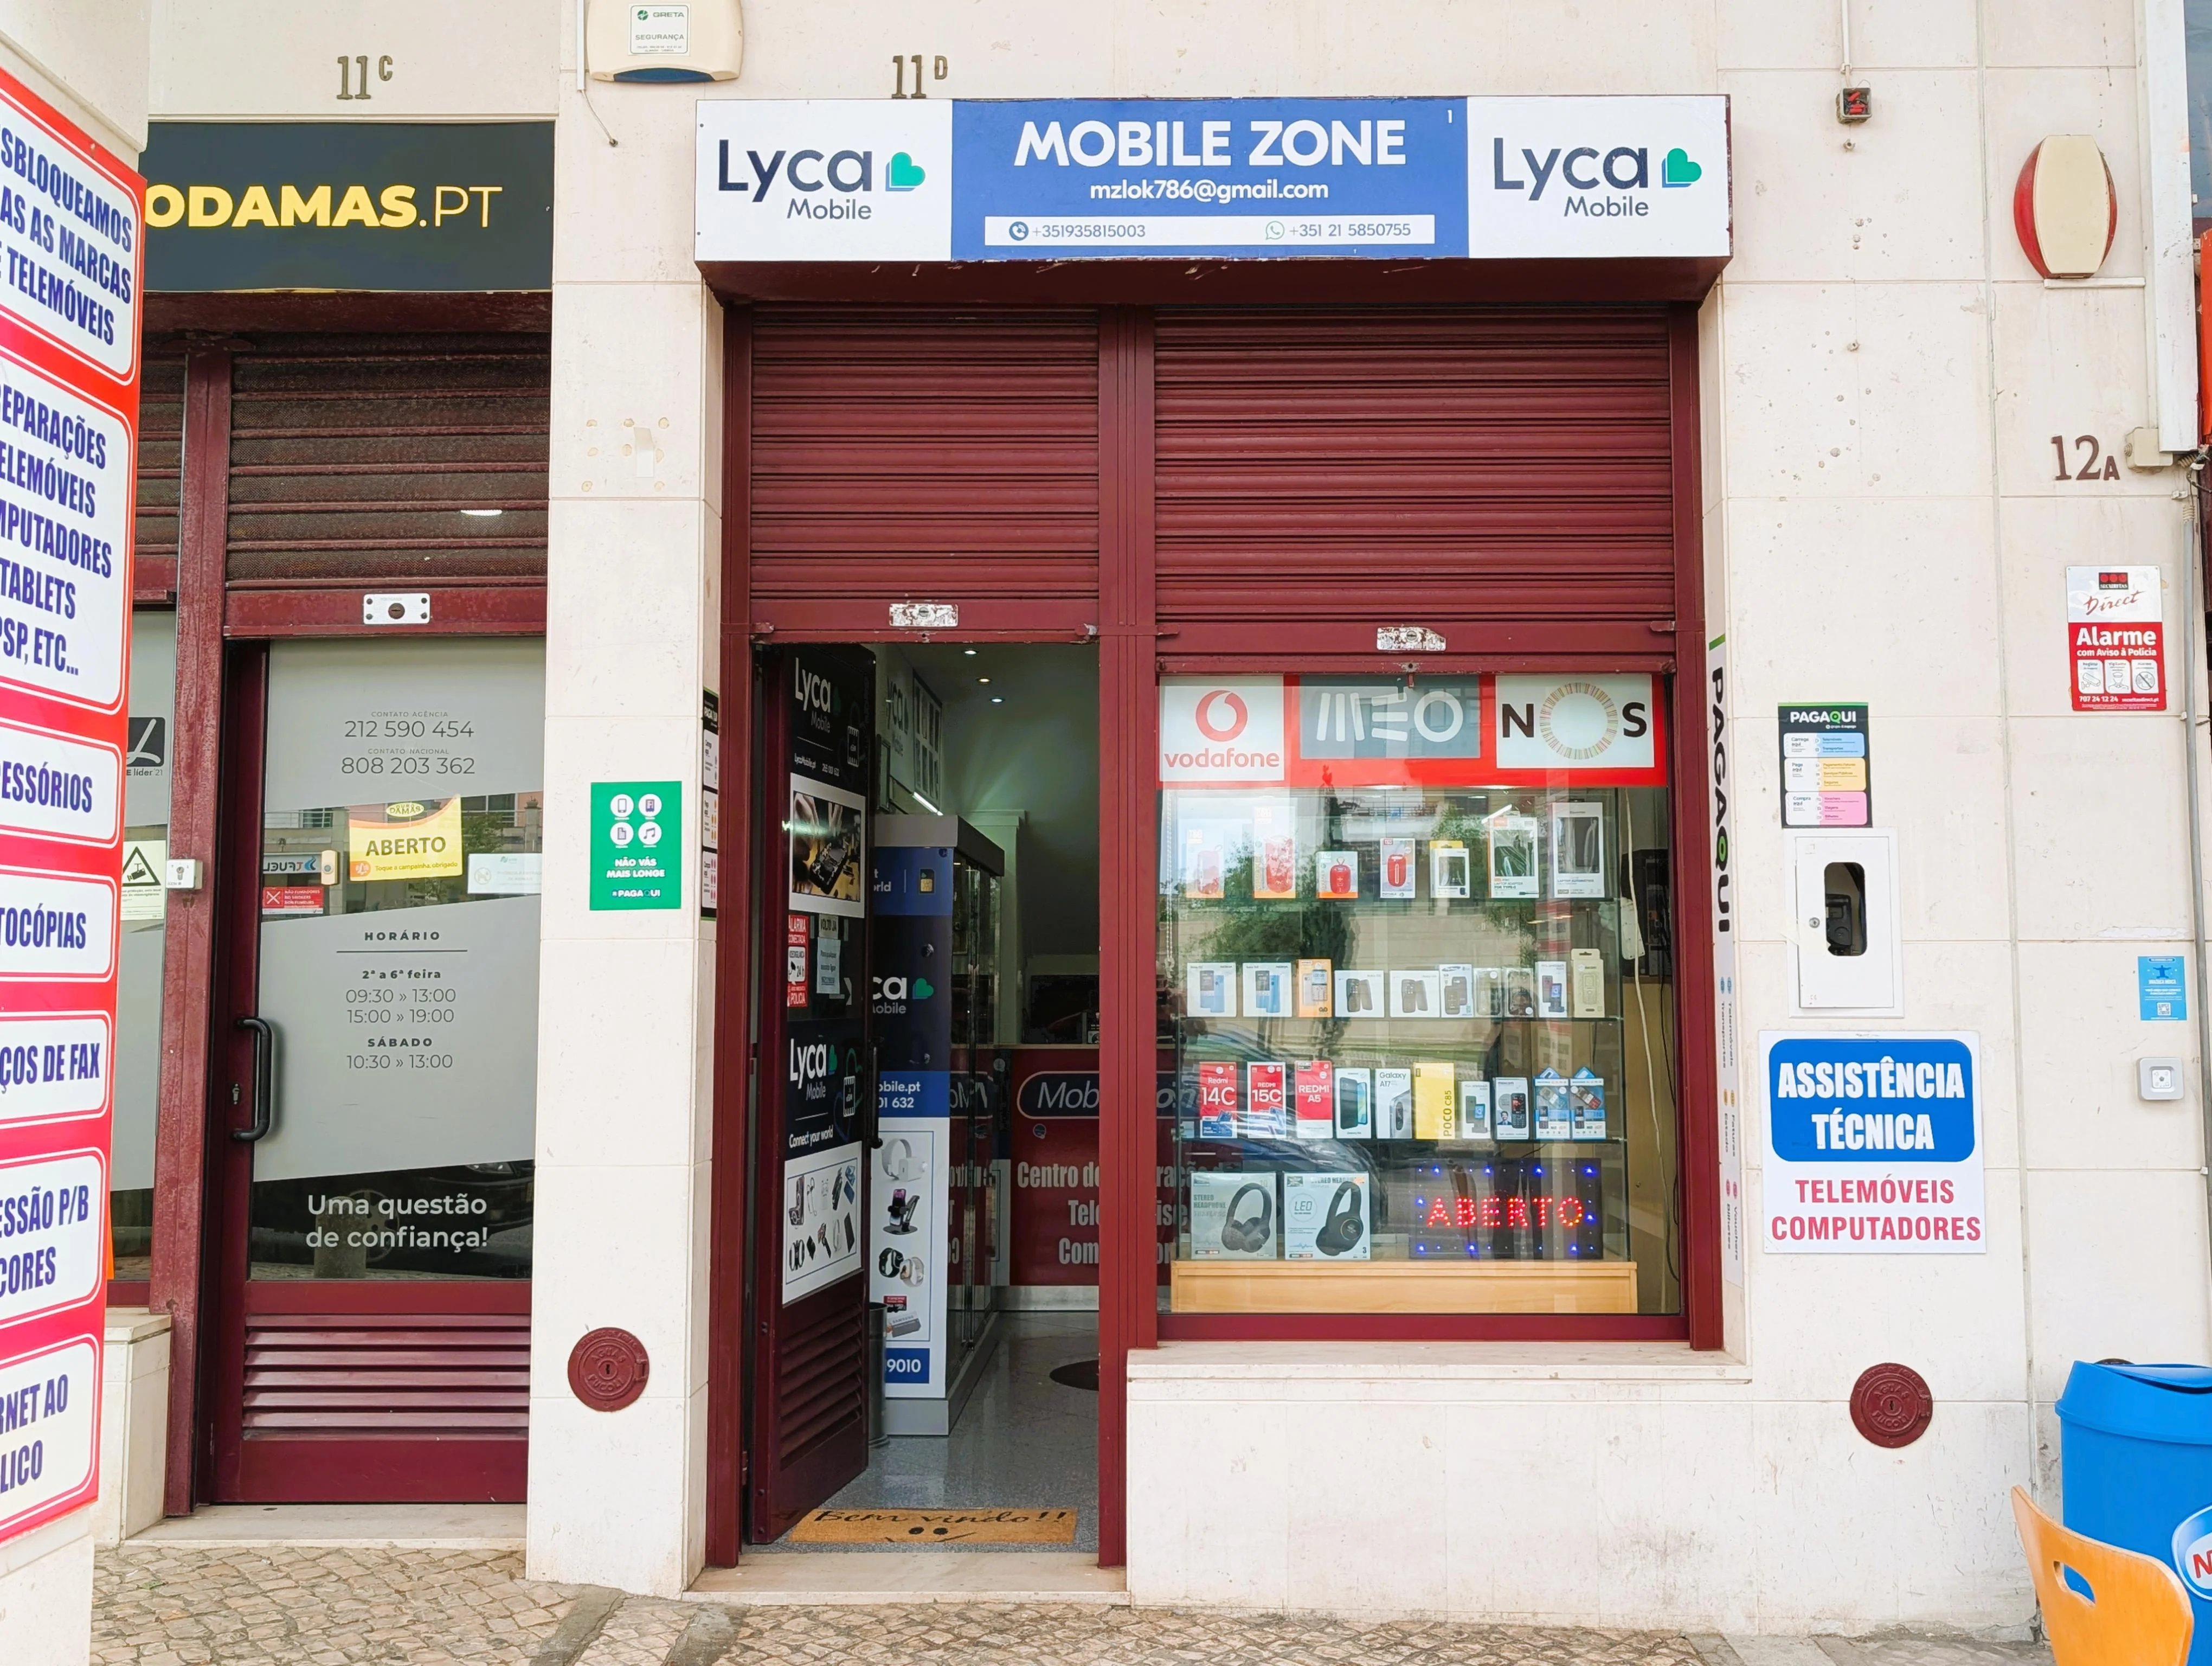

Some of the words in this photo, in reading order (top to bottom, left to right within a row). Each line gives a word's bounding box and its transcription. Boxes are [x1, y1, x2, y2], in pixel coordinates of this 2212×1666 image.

[1013, 120, 1232, 167] MOBILE
[1249, 119, 1406, 166] ZONE
[718, 139, 872, 202] Lyca
[1494, 137, 1648, 201] Lyca
[0, 127, 132, 253] SBLOQUEAMOS
[1090, 178, 1329, 204] mzlok786@gmail.com
[145, 184, 503, 228] ODAMAS.PT
[787, 198, 872, 220] Mobile
[1564, 195, 1649, 217] Mobile
[1032, 224, 1146, 239] +351935815003
[1289, 223, 1323, 238] +351
[1328, 223, 1343, 238] 21
[1348, 223, 1411, 238] 5850755
[30, 206, 54, 254] AS
[59, 224, 131, 304] MARCAS
[7, 246, 114, 346] TELEMÓVEIS
[0, 558, 76, 620] TABLETS
[2084, 590, 2147, 616] Direct
[2076, 626, 2157, 646] Alarme
[2097, 648, 2119, 656] Aviso
[2121, 648, 2126, 656] à
[795, 657, 831, 713] Lyca
[1502, 682, 1648, 760] NOS
[1790, 710, 1856, 723] PAGAQUI
[344, 721, 378, 738] 212
[384, 721, 425, 738] 590
[432, 720, 474, 738] 454
[341, 758, 384, 774] 808
[390, 758, 430, 774] 203
[436, 757, 475, 774] 362
[1164, 747, 1279, 768] vodafone
[133, 768, 153, 777] líder
[2, 761, 93, 813] ESSÓRIOS
[1711, 667, 1730, 932] PAGAQUI
[365, 836, 446, 856] ABERTO
[615, 856, 636, 867] NÃO
[638, 856, 657, 867] VÁS
[607, 870, 631, 878] MAIS
[633, 869, 665, 878] LONGE
[873, 881, 892, 892] rld
[364, 930, 440, 941] HORÁRIO
[379, 971, 387, 979] a
[407, 969, 441, 979] feira
[345, 988, 394, 1003] 09:30
[411, 988, 456, 1003] 13:00
[347, 1009, 391, 1023] 15:00
[409, 1008, 455, 1023] 19:00
[368, 1036, 433, 1047] SÁBADO
[43, 1045, 65, 1082] DE
[70, 1042, 101, 1080] FAX
[347, 1055, 391, 1069] 10:30
[408, 1054, 453, 1069] 13:00
[790, 1038, 827, 1090] Lyca
[1778, 1055, 1965, 1099] ASSISTÊNCIA
[806, 1081, 826, 1101] Mobile
[1201, 1086, 1236, 1106] 14C
[1252, 1089, 1282, 1103] 15C
[1298, 1085, 1330, 1093] REDMI
[1307, 1094, 1321, 1103] A5
[892, 1097, 914, 1108] 632
[1443, 1108, 1452, 1137] POCO
[1811, 1107, 1935, 1150] TÉCNICA
[789, 1131, 809, 1149] Connect
[809, 1131, 820, 1147] your
[820, 1124, 834, 1140] world
[1018, 1162, 1078, 1188] Centro
[1795, 1174, 1954, 1204] TELEMÓVEIS
[59, 1184, 89, 1227] P/B
[307, 1195, 370, 1215] Uma
[378, 1193, 487, 1219] questão
[1294, 1201, 1313, 1211] LED
[1426, 1196, 1584, 1227] ABERTO
[306, 1227, 339, 1248] de
[348, 1226, 488, 1253] confiança!
[1772, 1216, 1980, 1241] COMPUTADORES
[887, 1359, 922, 1373] 9010
[44, 1374, 69, 1419] AO
[813, 1510, 907, 1523] Bem
